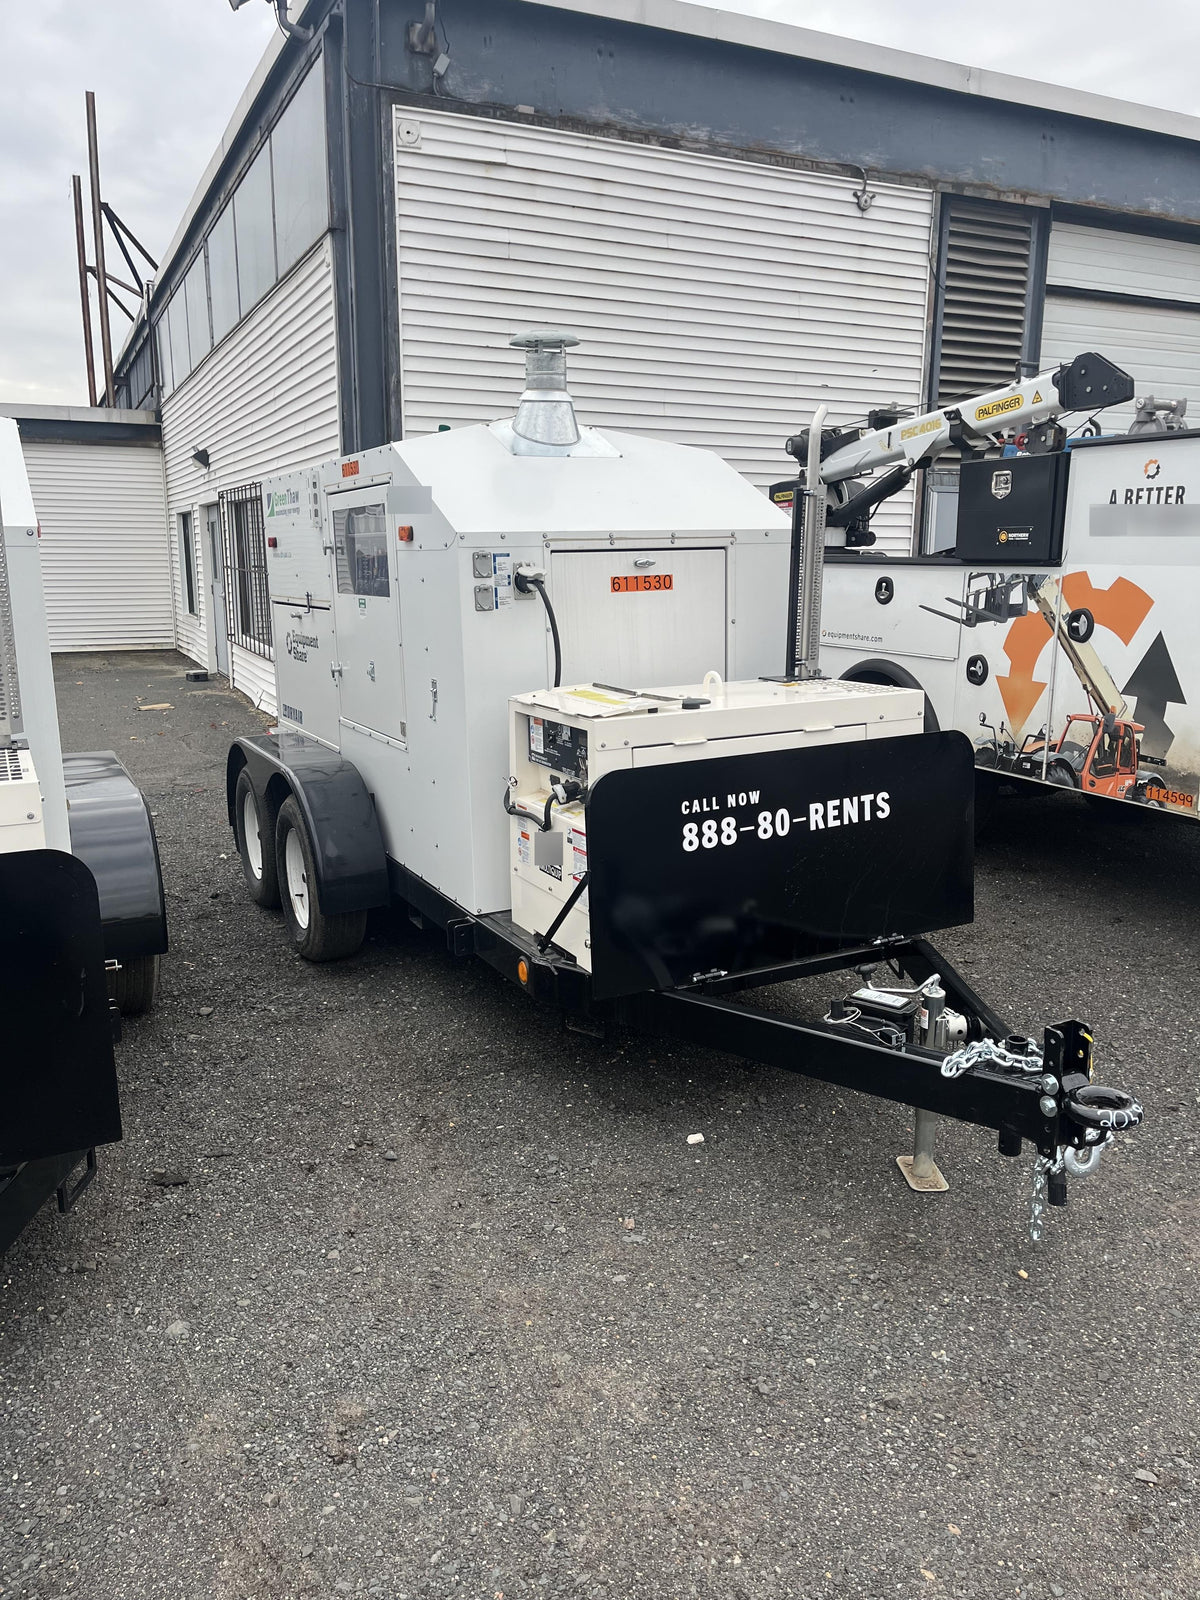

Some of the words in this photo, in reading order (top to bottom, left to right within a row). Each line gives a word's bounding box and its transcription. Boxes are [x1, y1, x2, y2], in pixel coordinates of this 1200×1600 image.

[978, 397, 1021, 418] PALFINGER
[901, 426, 918, 440] PSC
[919, 418, 942, 434] 4016
[1109, 489, 1117, 504] A
[1124, 486, 1186, 504] BETTER
[612, 575, 672, 592] 611530
[292, 630, 319, 648] Equipment
[828, 631, 883, 643] equipmentshare.com
[293, 647, 307, 662] Share
[681, 797, 720, 815] CALL
[727, 790, 761, 808] NOW
[1148, 787, 1193, 807] 114599
[682, 791, 891, 852] 888-80-RENTS
